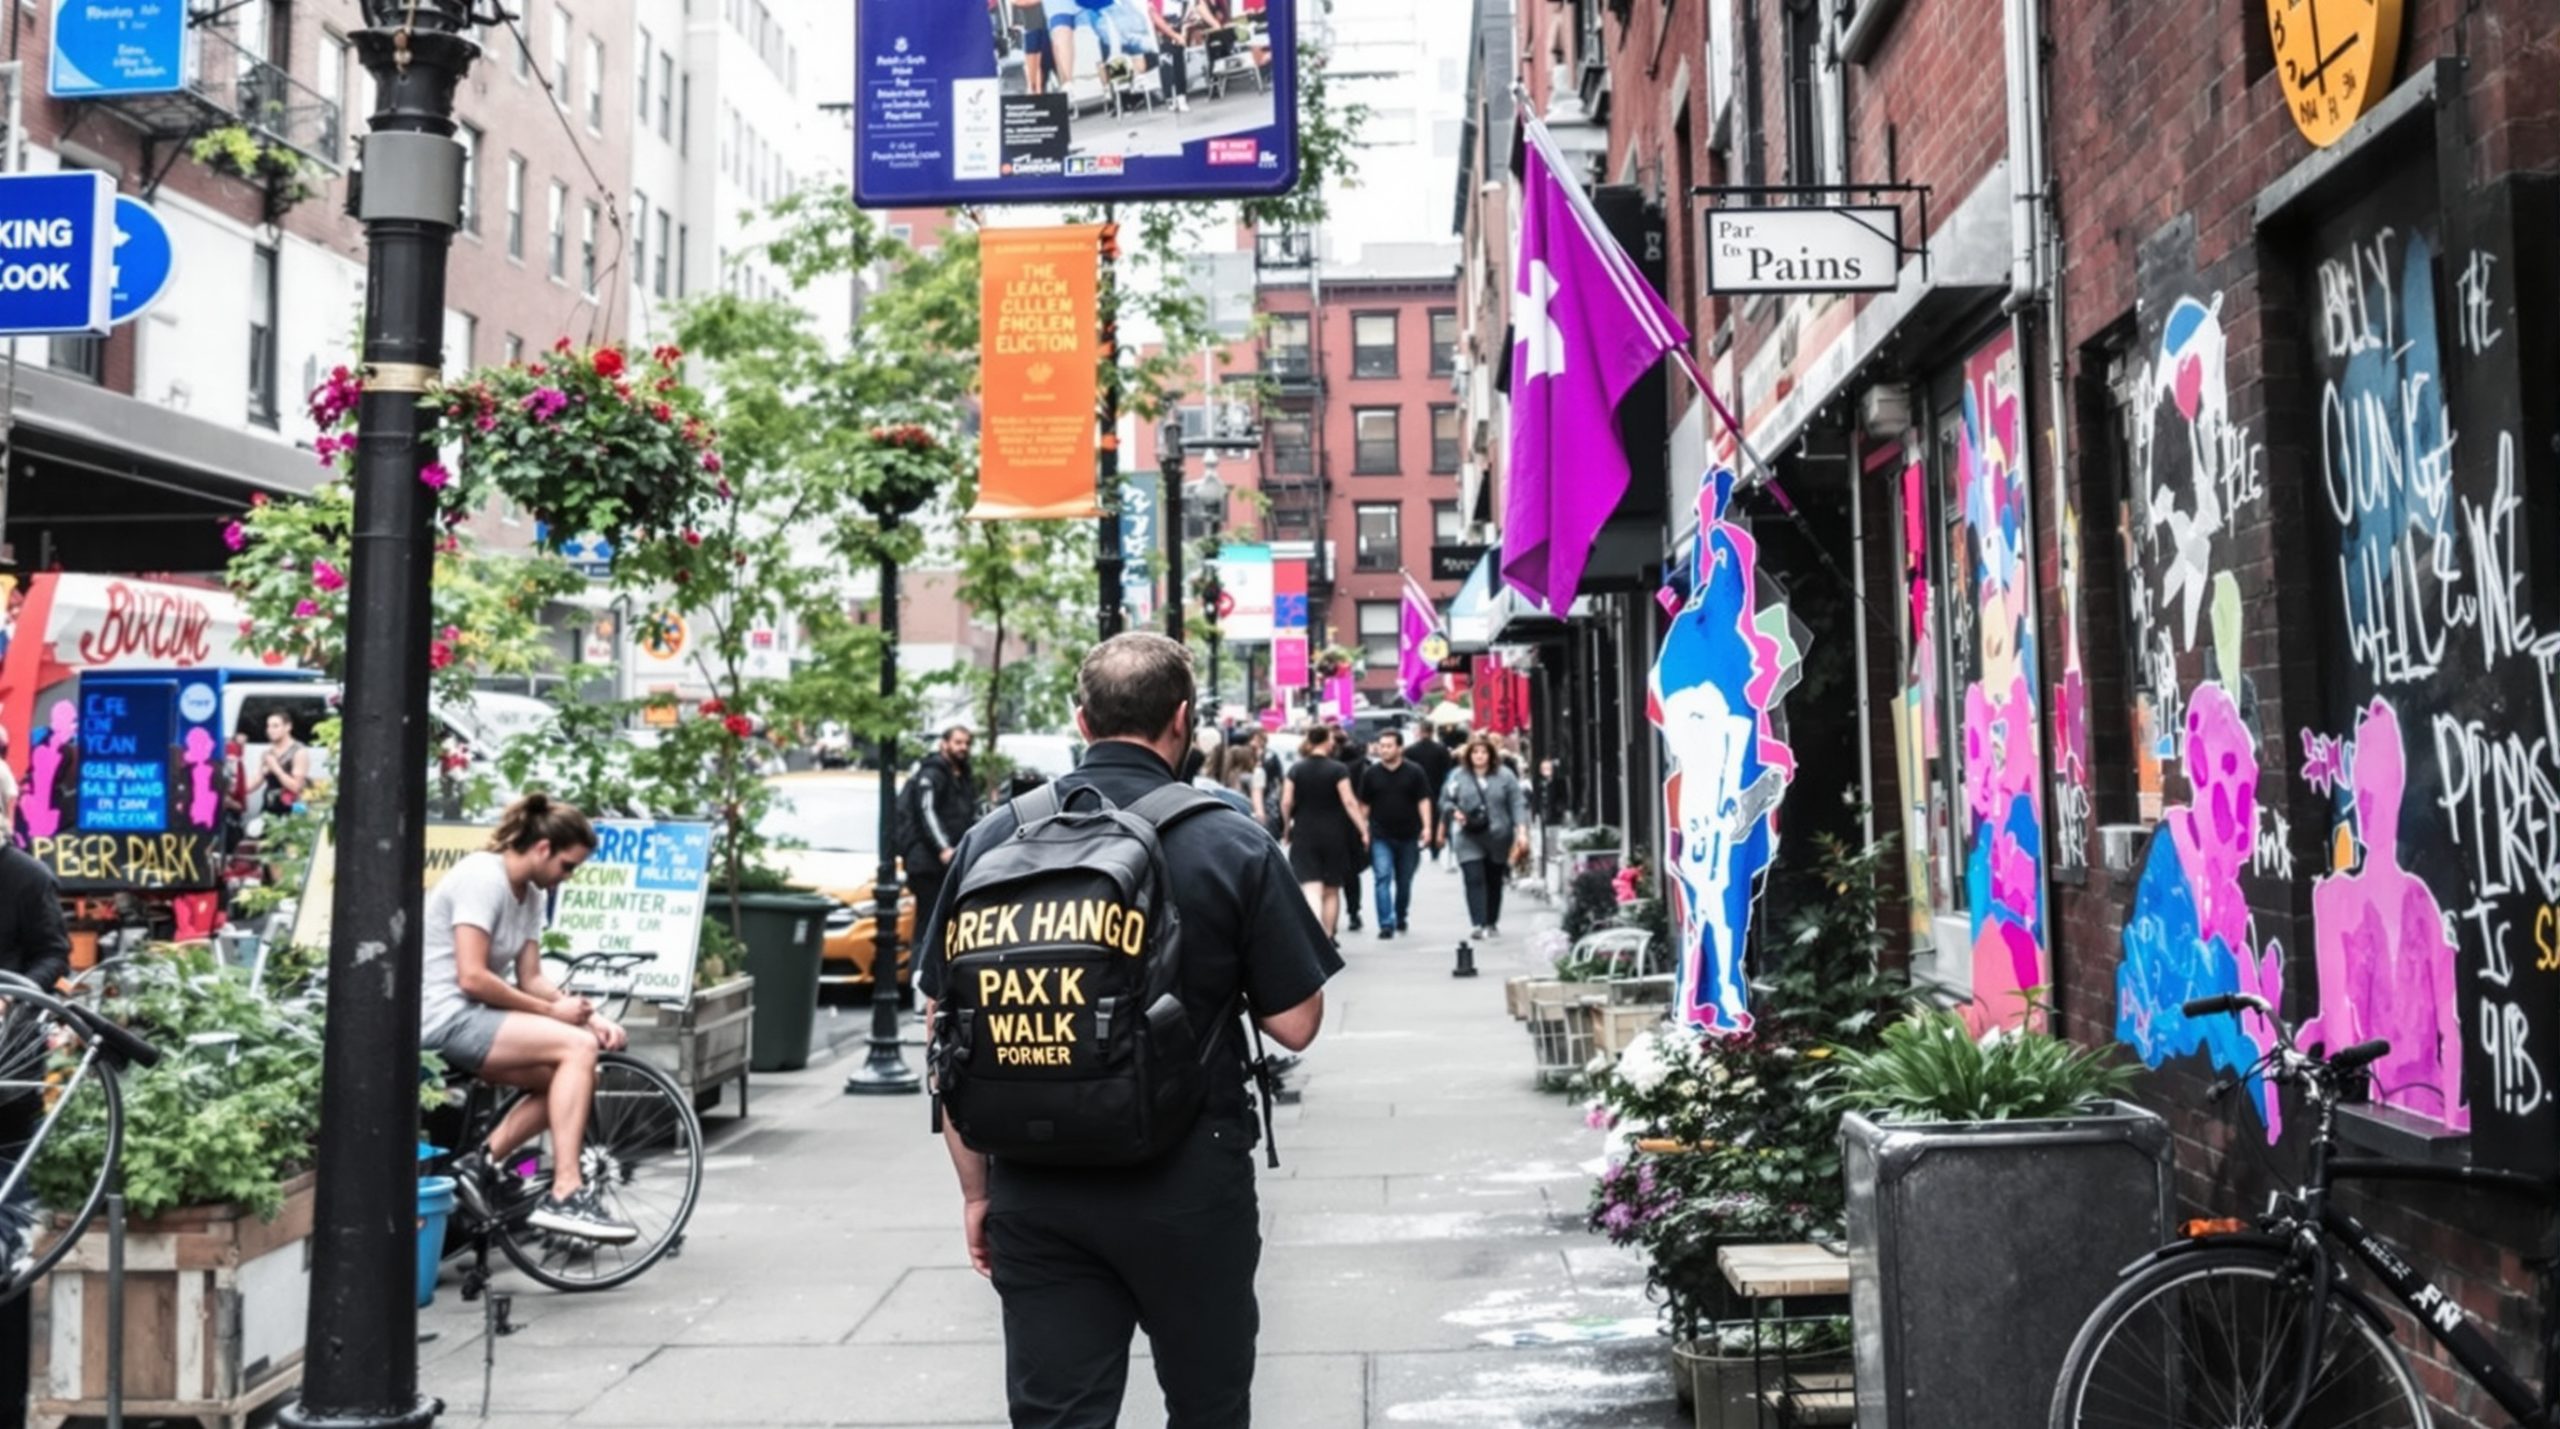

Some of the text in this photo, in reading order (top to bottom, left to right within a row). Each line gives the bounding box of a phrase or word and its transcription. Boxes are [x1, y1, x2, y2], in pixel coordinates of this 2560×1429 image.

[1719, 221, 1754, 238] Par
[0, 259, 71, 291] OOK
[1748, 247, 1862, 281] Pains
[988, 1012, 1077, 1043] WALK
